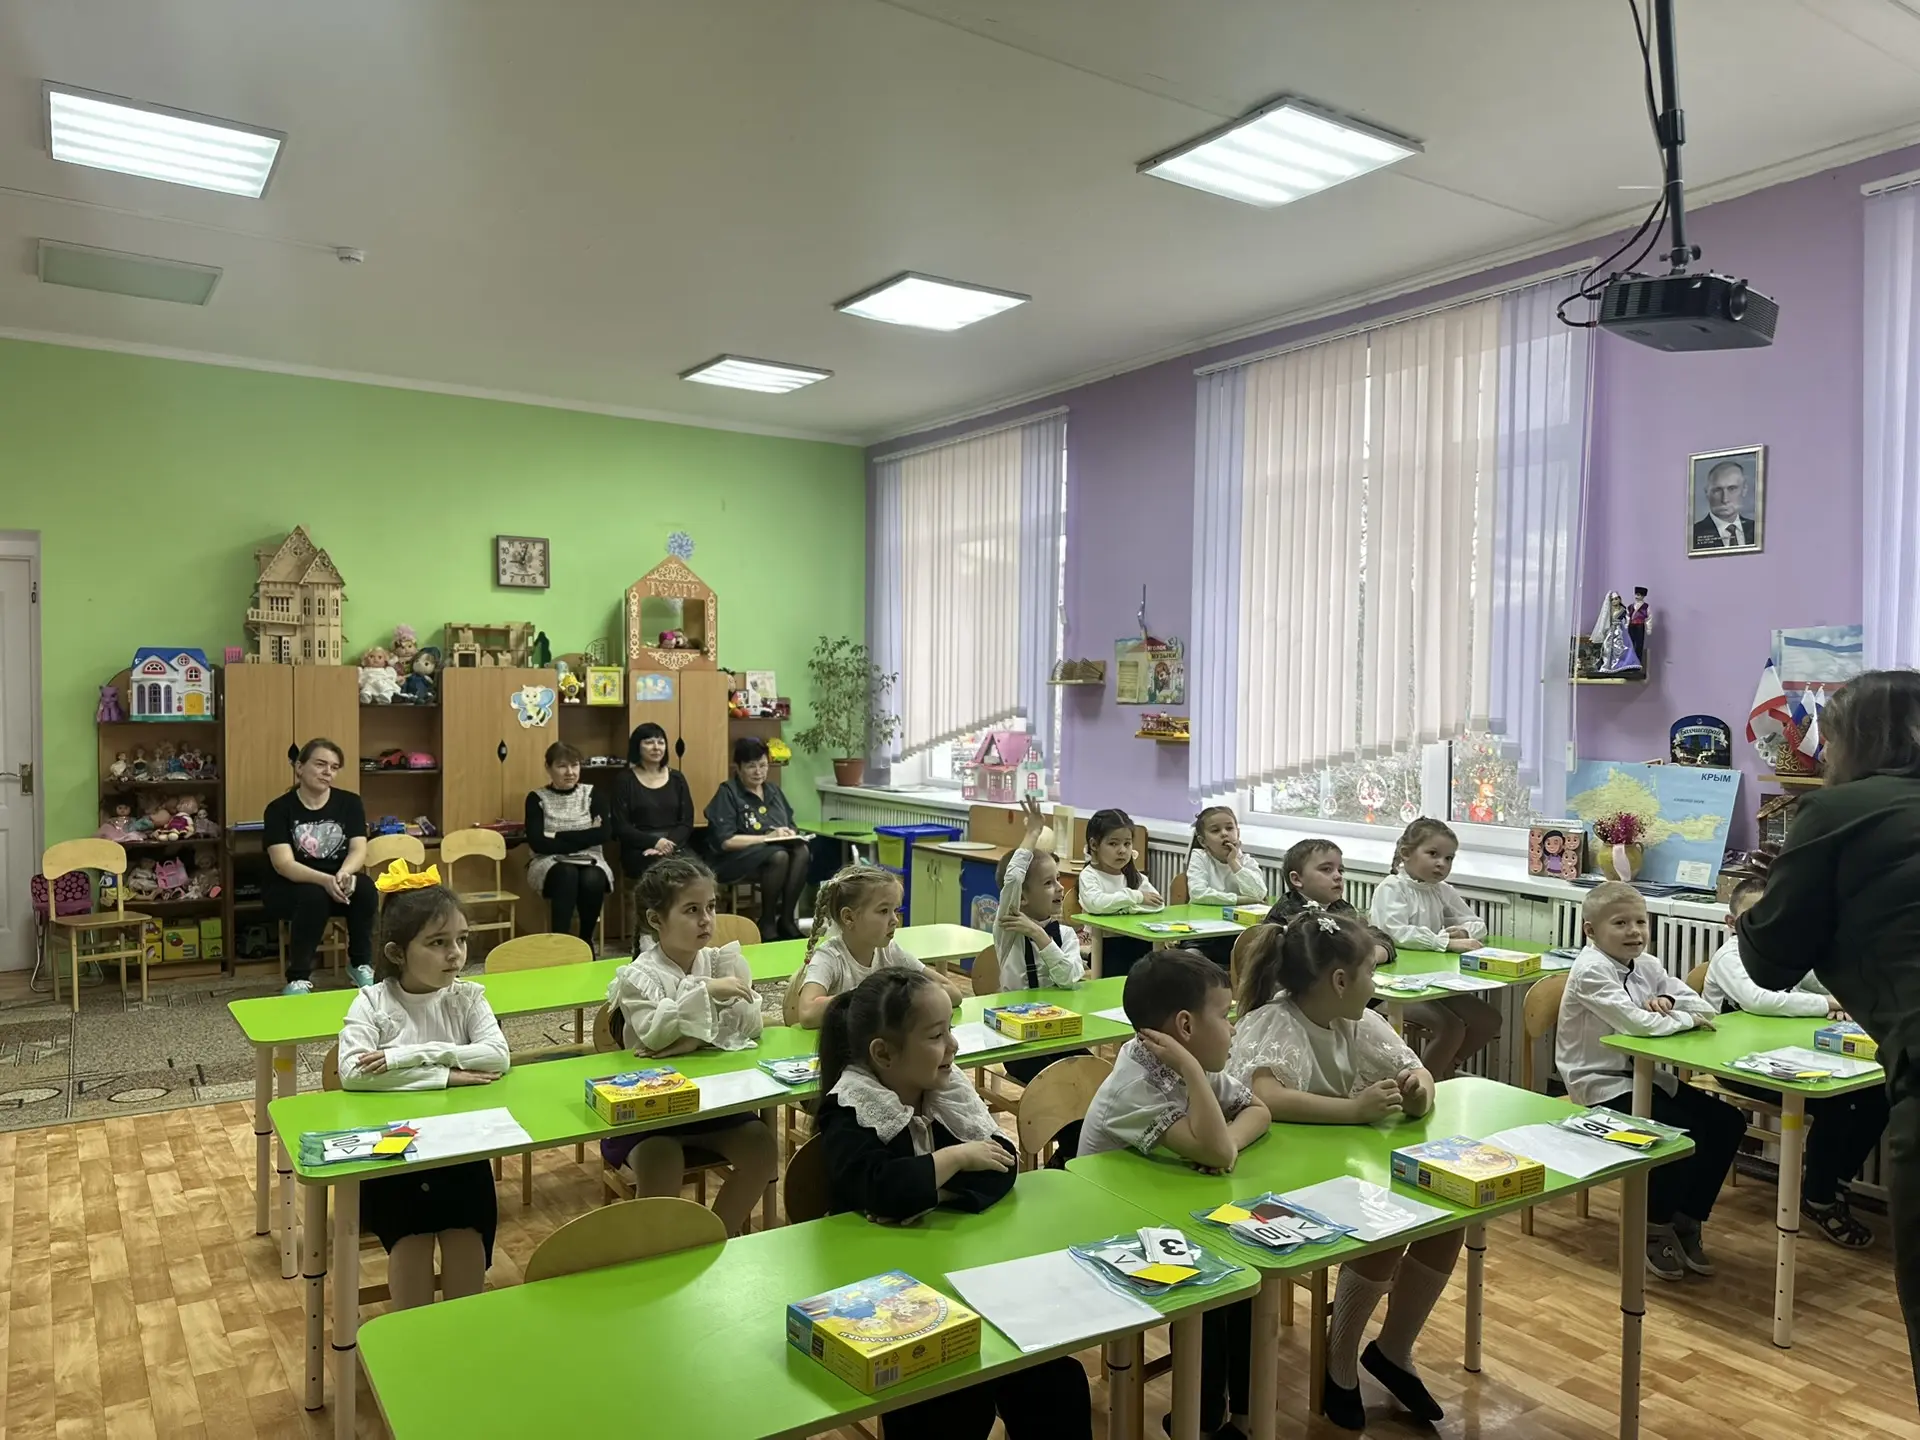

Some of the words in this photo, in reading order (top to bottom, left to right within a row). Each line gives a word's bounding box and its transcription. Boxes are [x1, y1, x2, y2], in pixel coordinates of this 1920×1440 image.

[501, 546, 510, 555] 10
[501, 557, 507, 565] 9
[501, 568, 507, 576] 8
[646, 580, 700, 597] ТЕАТР
[1680, 727, 1722, 736] Бахчисарай
[1701, 773, 1731, 782] КРЫМ
[1254, 1226, 1292, 1240] 10
[1159, 1238, 1186, 1256] 3
[839, 1332, 895, 1343] ПАЛОЧКИ
